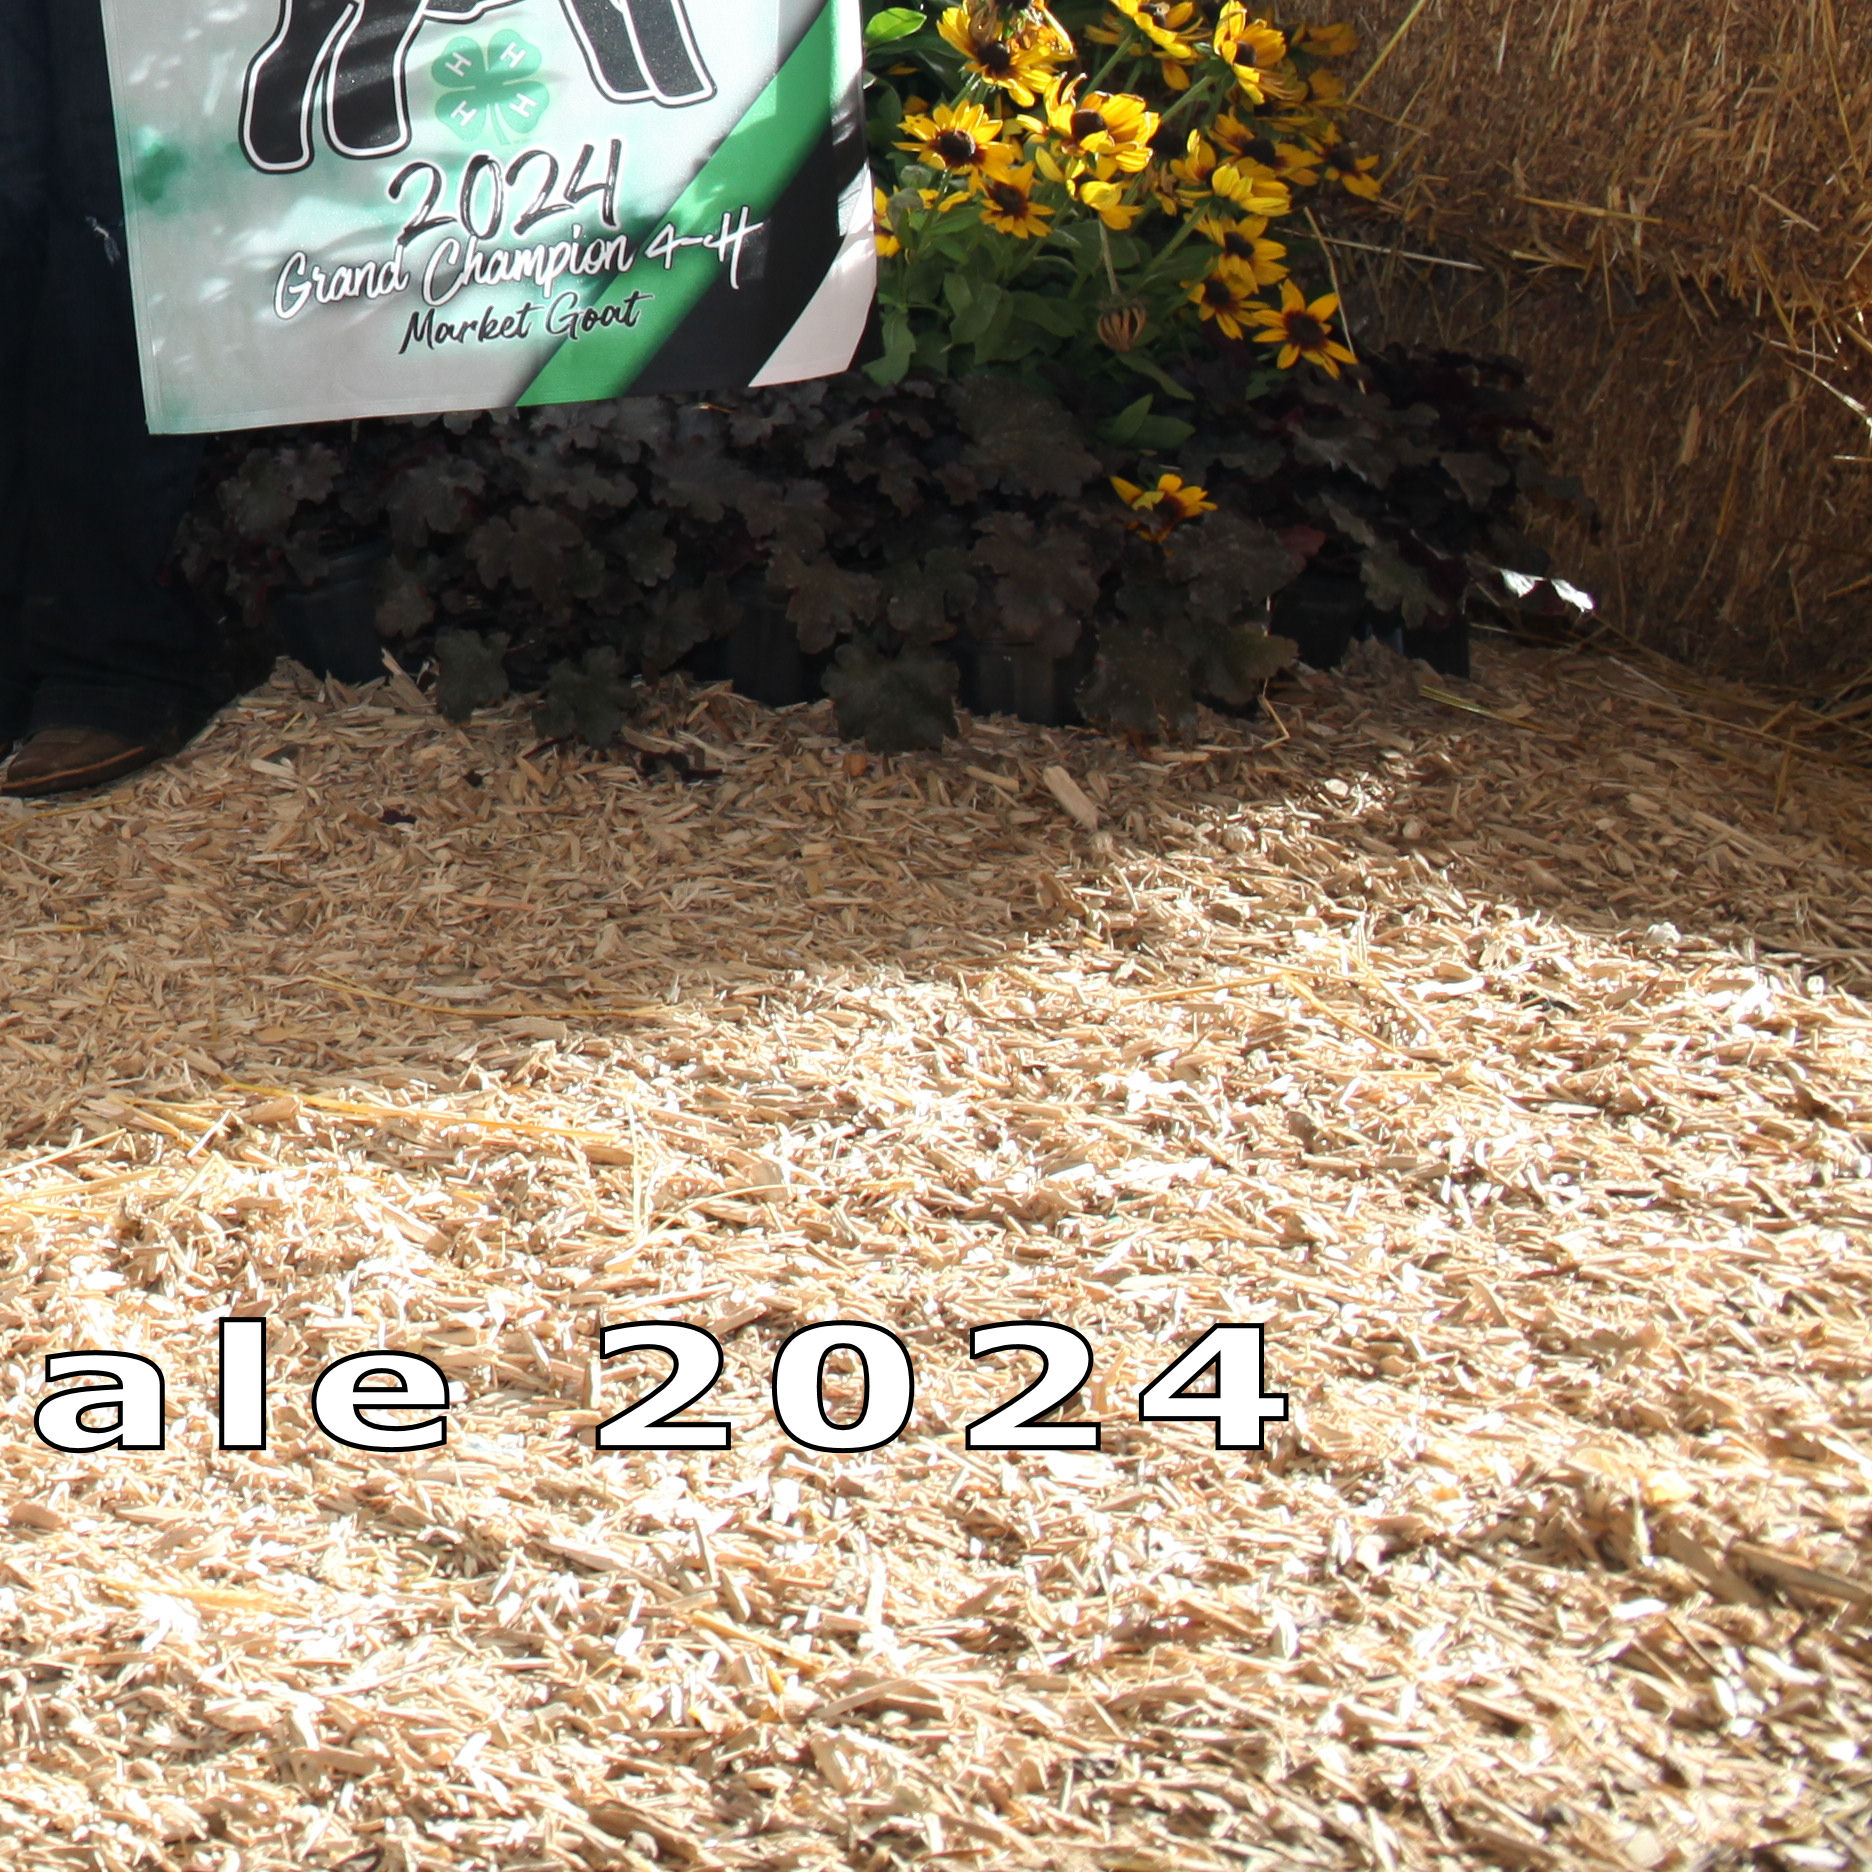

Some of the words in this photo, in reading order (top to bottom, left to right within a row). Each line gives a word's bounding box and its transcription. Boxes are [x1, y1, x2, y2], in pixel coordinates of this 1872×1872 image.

[388, 138, 622, 245] 2024
[274, 244, 410, 320] Grand
[421, 223, 634, 307] Champion
[645, 206, 764, 290] 4-H
[399, 304, 544, 355] Market
[545, 291, 654, 339] Goat
